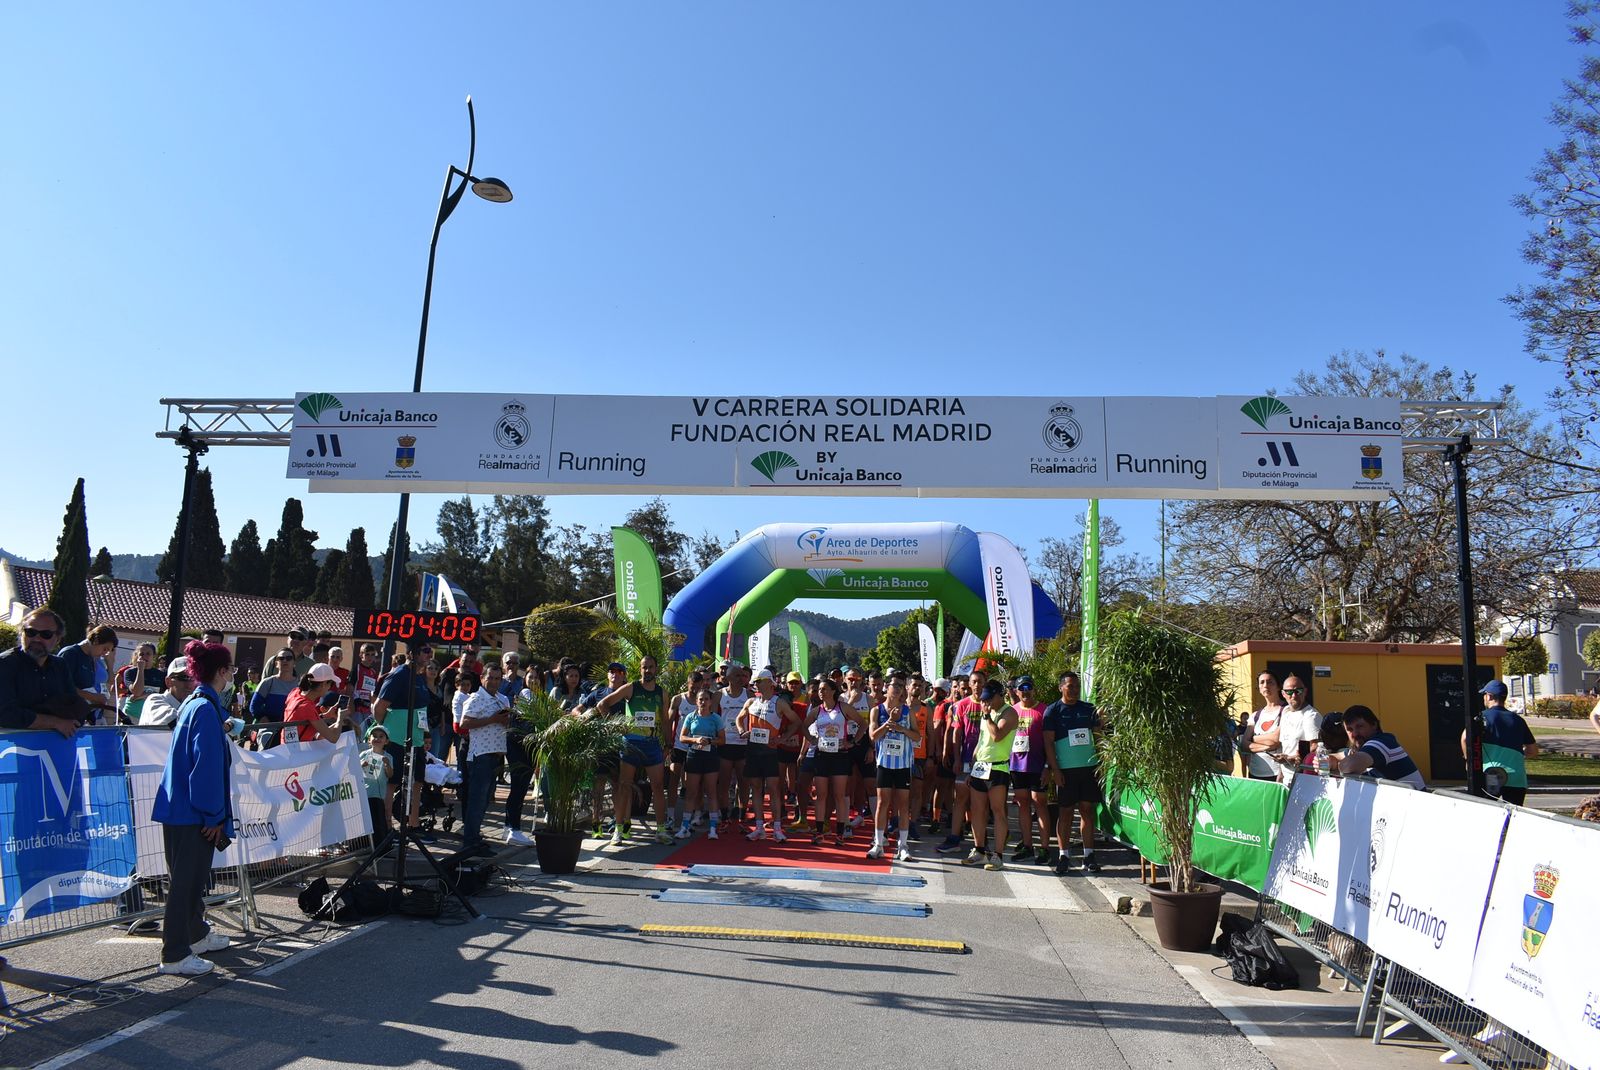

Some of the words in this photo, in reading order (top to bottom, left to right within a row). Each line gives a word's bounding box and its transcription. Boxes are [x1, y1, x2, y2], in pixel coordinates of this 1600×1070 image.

[339, 408, 392, 424] Unicaja
[395, 410, 438, 422] Banco
[692, 398, 710, 417] V
[714, 398, 829, 417] CARRERA
[836, 397, 966, 417] SOLIDARIA
[671, 419, 815, 443] FUNDACIÓN
[824, 424, 885, 442] REAL
[893, 423, 992, 442] MADRID
[1289, 414, 1351, 433] Unicaja
[1353, 417, 1402, 431] Banco
[291, 460, 325, 470] Diputación
[326, 461, 357, 469] Provincial
[478, 459, 540, 471] Realmadrid
[479, 452, 541, 460] FUNDACIÓN
[558, 451, 646, 477] Running
[816, 451, 838, 463] BY
[316, 469, 340, 478] Málaga
[796, 467, 853, 484] Unicaja
[856, 468, 902, 481] Banco
[1030, 463, 1097, 474] Realmadrid
[1116, 453, 1207, 480] Running
[1242, 471, 1281, 480] Diputación
[1282, 471, 1318, 479] Provincial
[1272, 479, 1299, 489] Málaga
[854, 537, 867, 548] de
[870, 537, 918, 549] Deportes
[625, 560, 638, 600] Banco
[842, 575, 889, 590] Unicaja
[891, 577, 929, 588] Banco
[994, 566, 1008, 606] Banco
[367, 612, 478, 642] 10:04:08
[5, 830, 64, 855] diputación
[66, 828, 82, 842] de
[85, 822, 129, 841] málaga
[232, 818, 278, 841] Running
[1212, 825, 1238, 840] Unicaja
[1237, 829, 1262, 843] Banco
[1292, 863, 1314, 884] Unicaja
[1313, 872, 1330, 889] Banco
[1386, 890, 1448, 950] Running
